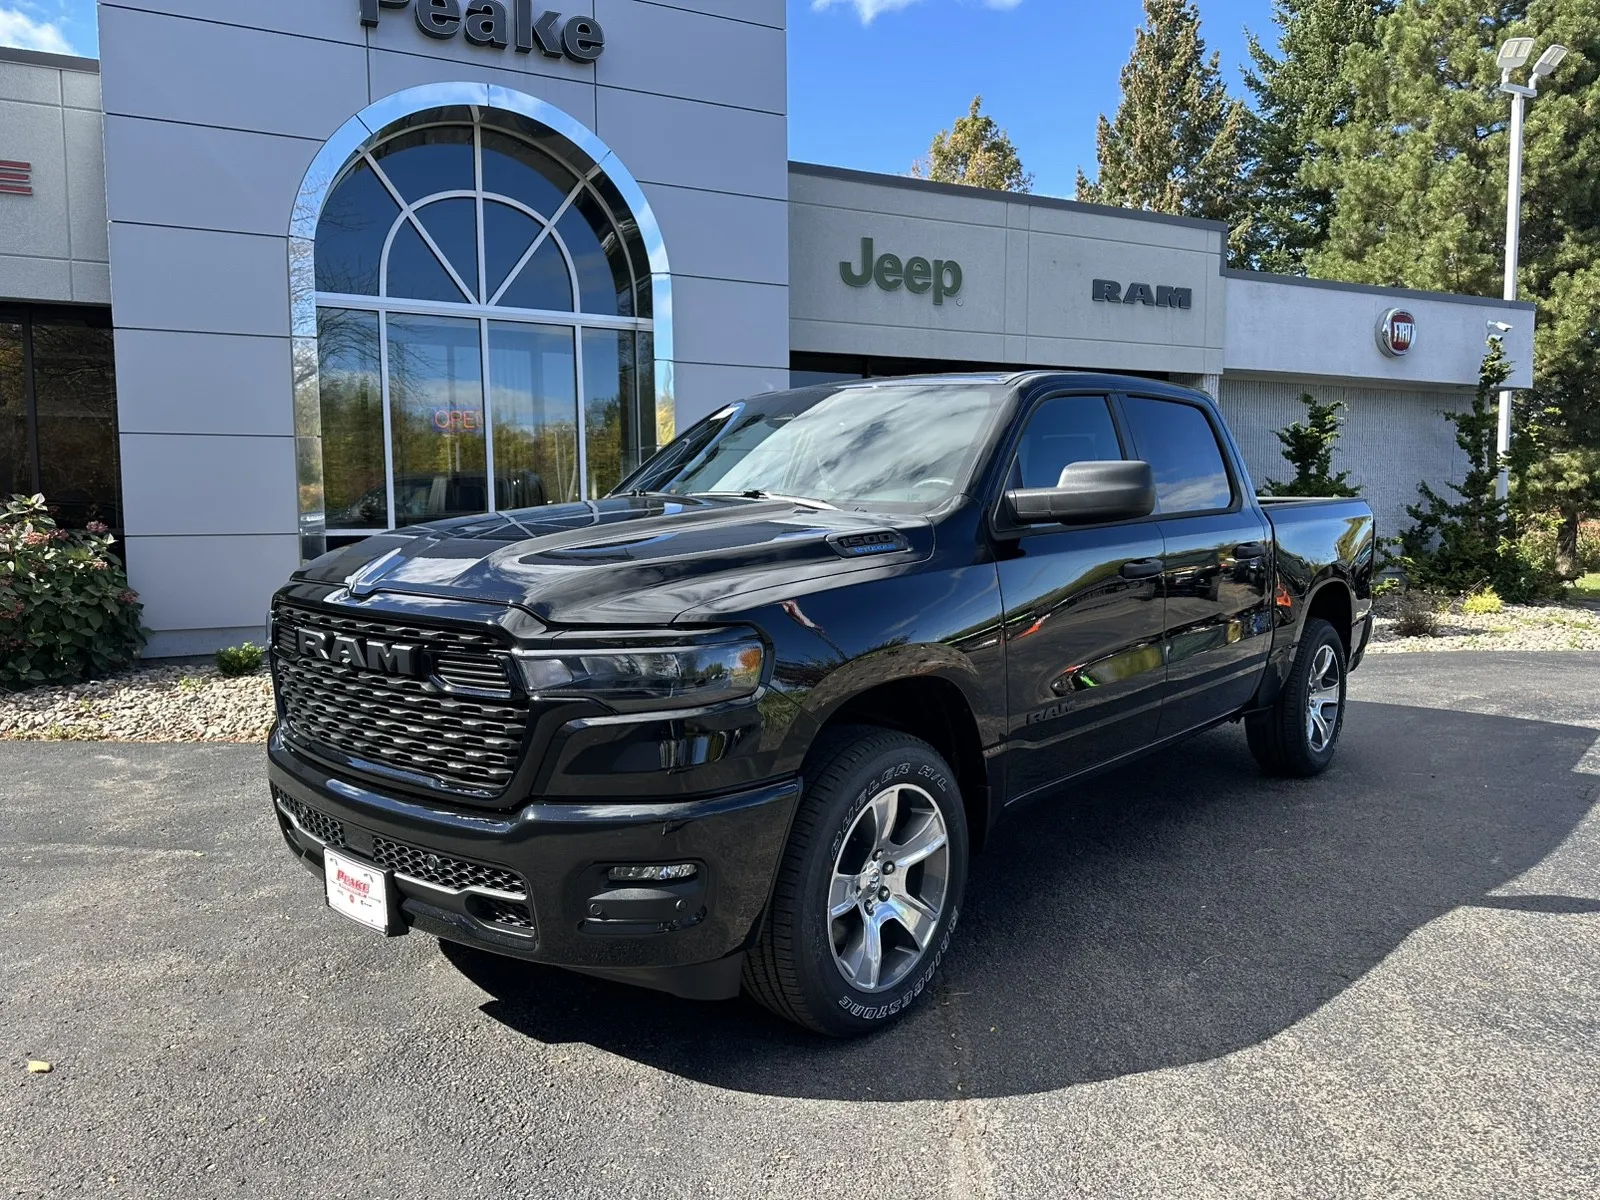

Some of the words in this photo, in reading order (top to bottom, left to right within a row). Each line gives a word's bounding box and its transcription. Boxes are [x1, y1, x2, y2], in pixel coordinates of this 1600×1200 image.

[839, 236, 963, 305] Jeep
[1091, 278, 1193, 309] RAM
[1393, 321, 1412, 343] FIAT
[838, 532, 892, 548] 1500
[297, 627, 416, 676] RAM
[1025, 701, 1076, 724] RAM
